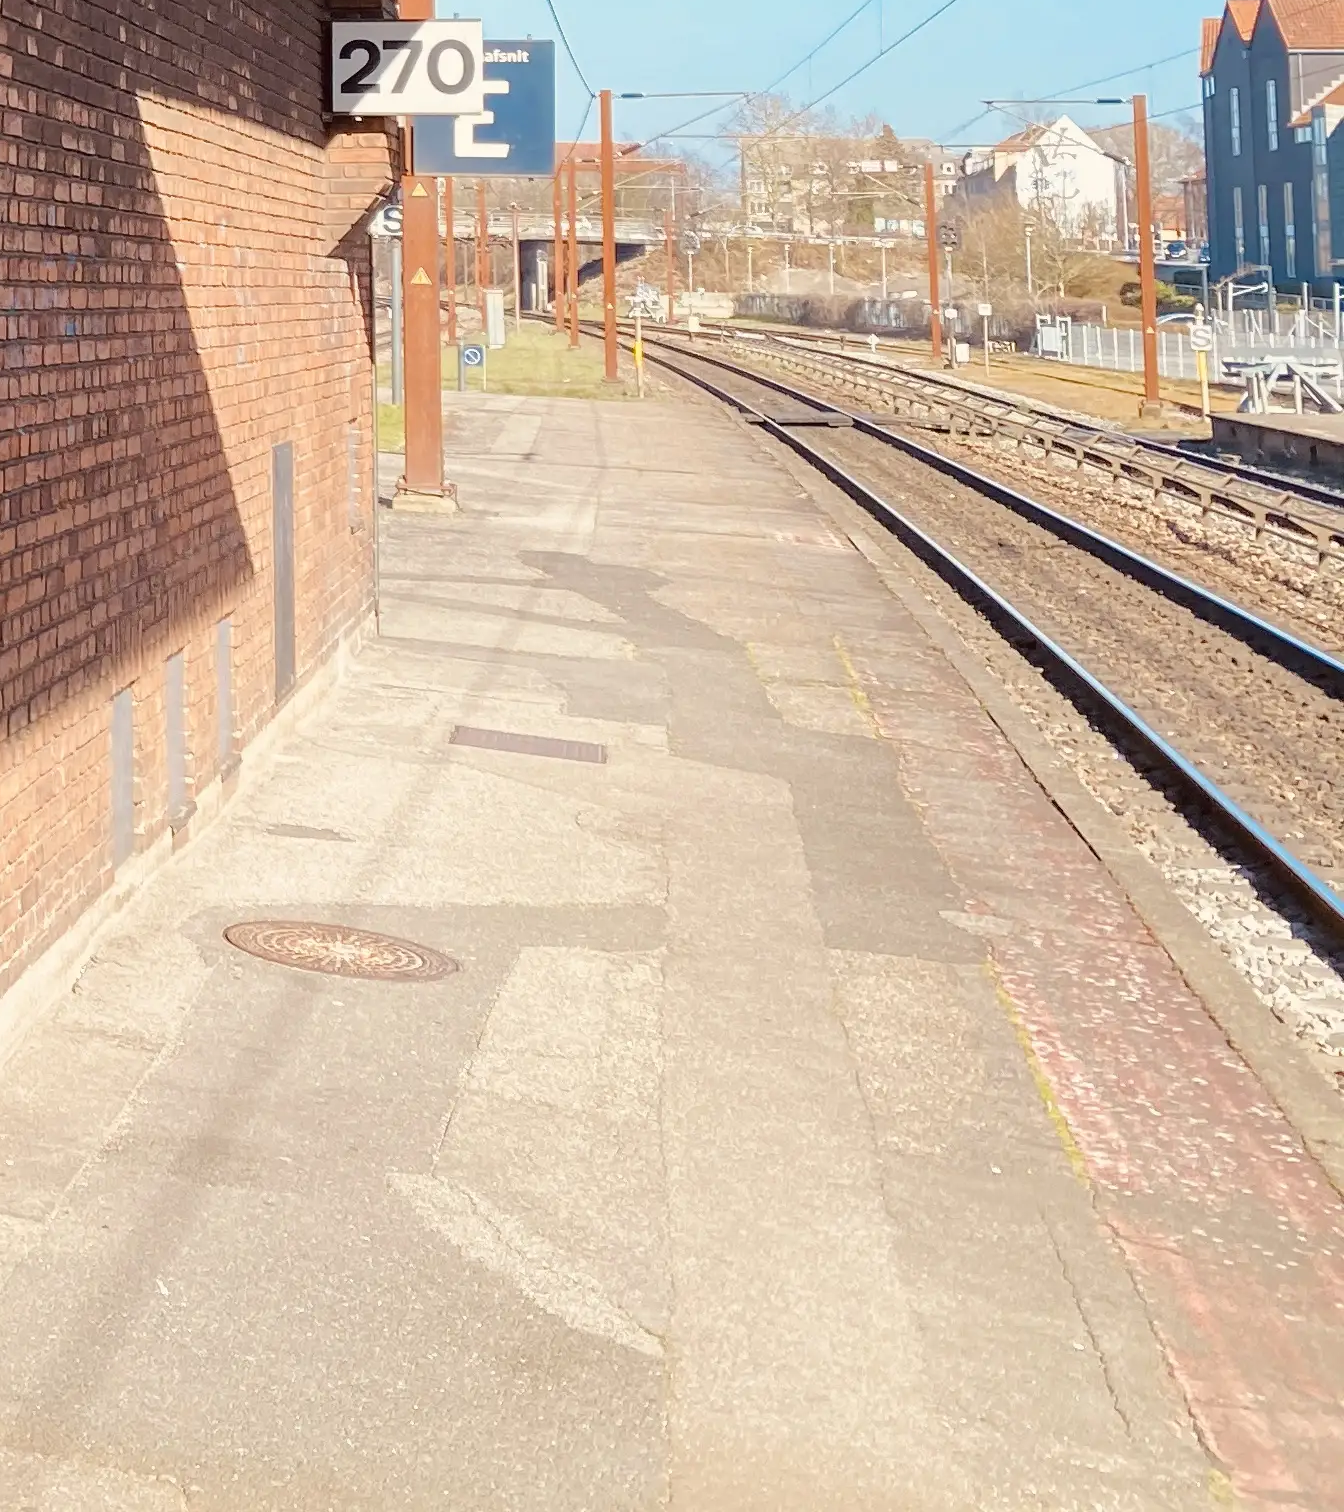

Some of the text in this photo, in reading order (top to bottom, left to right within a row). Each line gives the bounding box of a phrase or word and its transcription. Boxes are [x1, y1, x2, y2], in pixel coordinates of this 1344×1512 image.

[339, 39, 475, 94] 270
[454, 80, 510, 158] E
[383, 206, 404, 234] S
